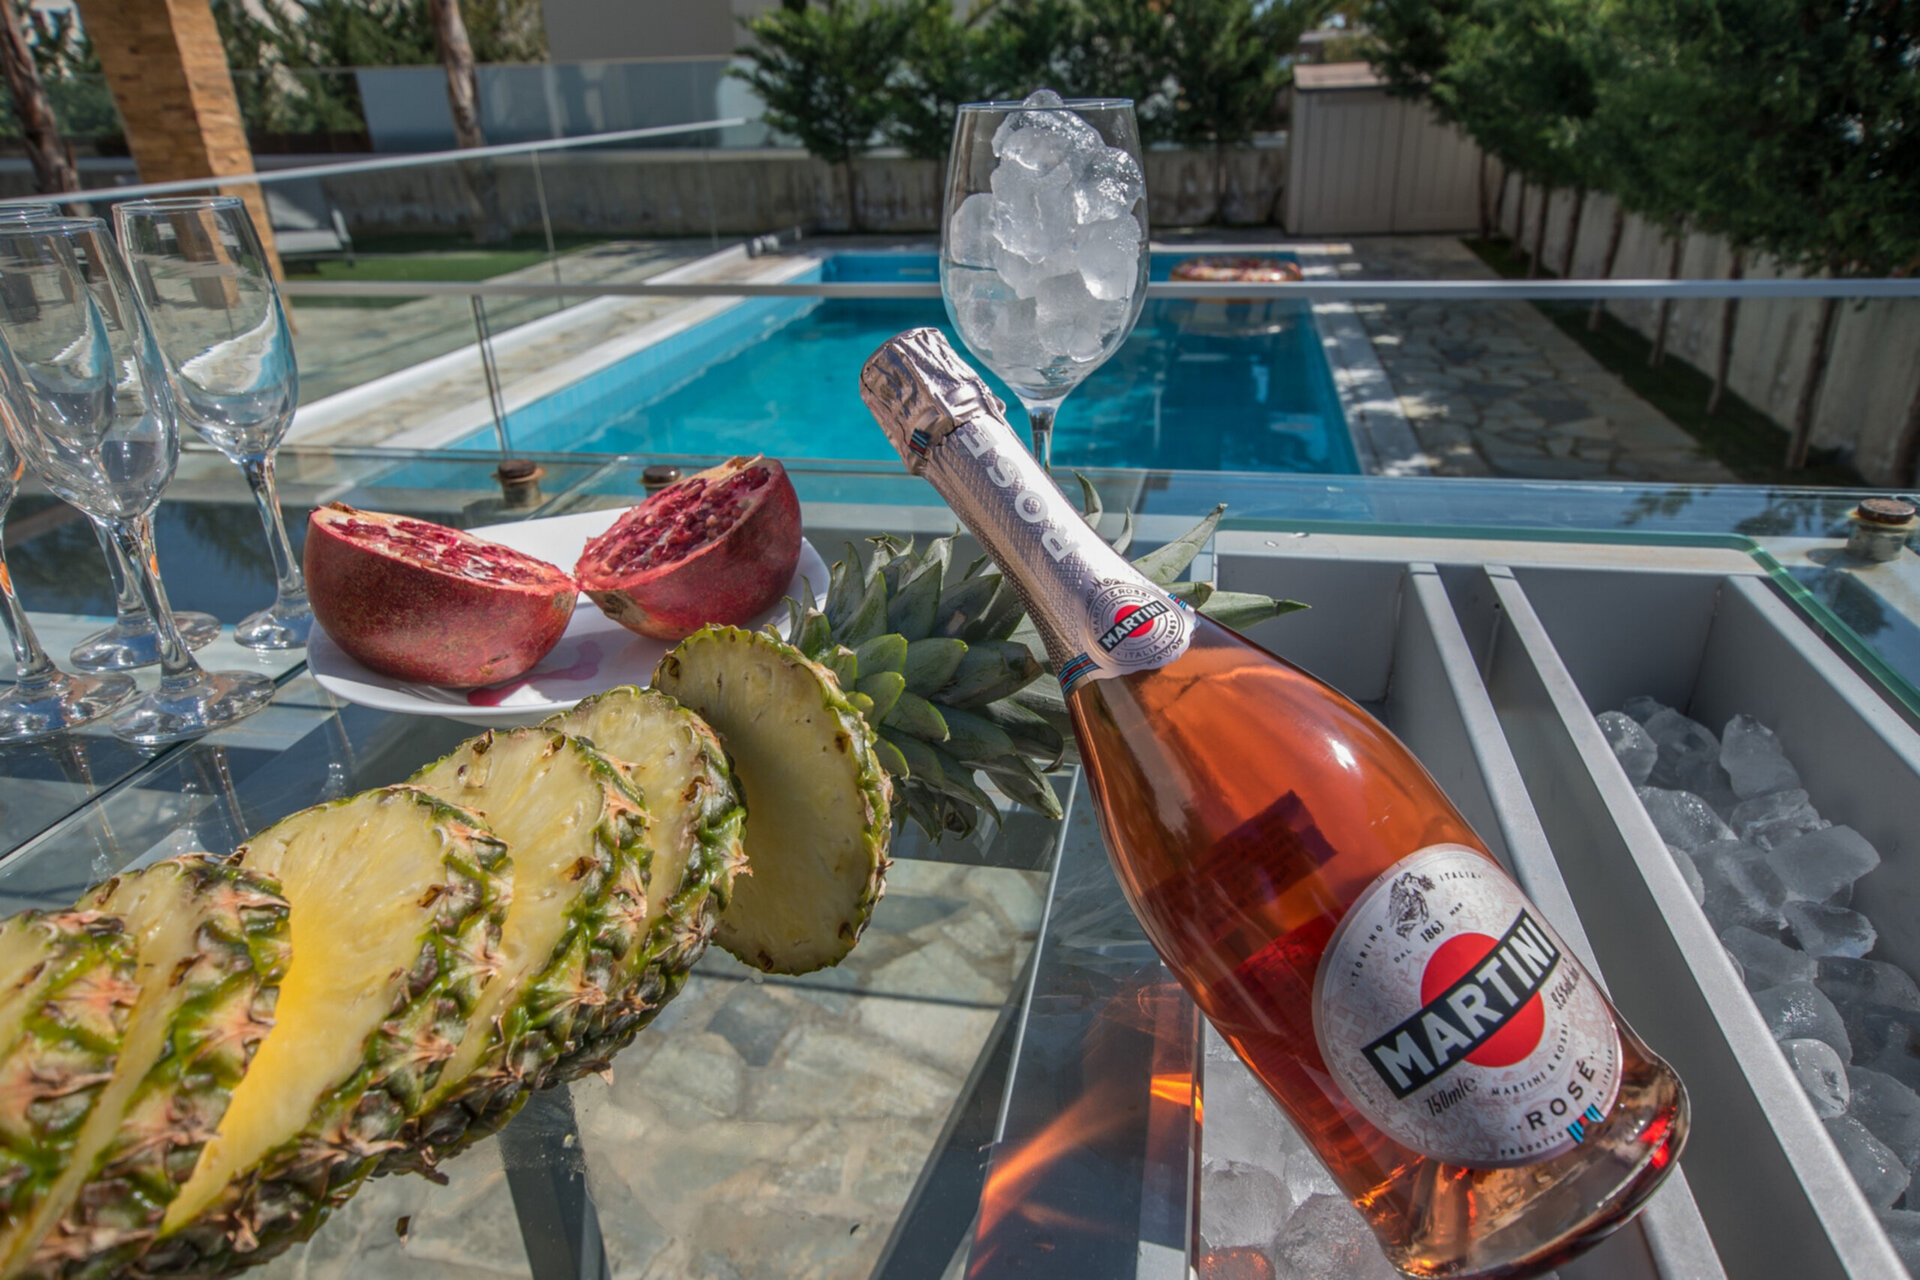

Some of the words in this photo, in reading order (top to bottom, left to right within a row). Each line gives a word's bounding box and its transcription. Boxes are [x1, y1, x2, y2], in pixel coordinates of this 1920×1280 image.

[1101, 601, 1166, 649] MARTINI
[1351, 924, 1384, 979] TORINO
[1420, 919, 1445, 944] 1863
[1373, 916, 1557, 1091] MARTINI
[1491, 1071, 1547, 1097] MARTINI
[1526, 1058, 1595, 1130] ROSÉ
